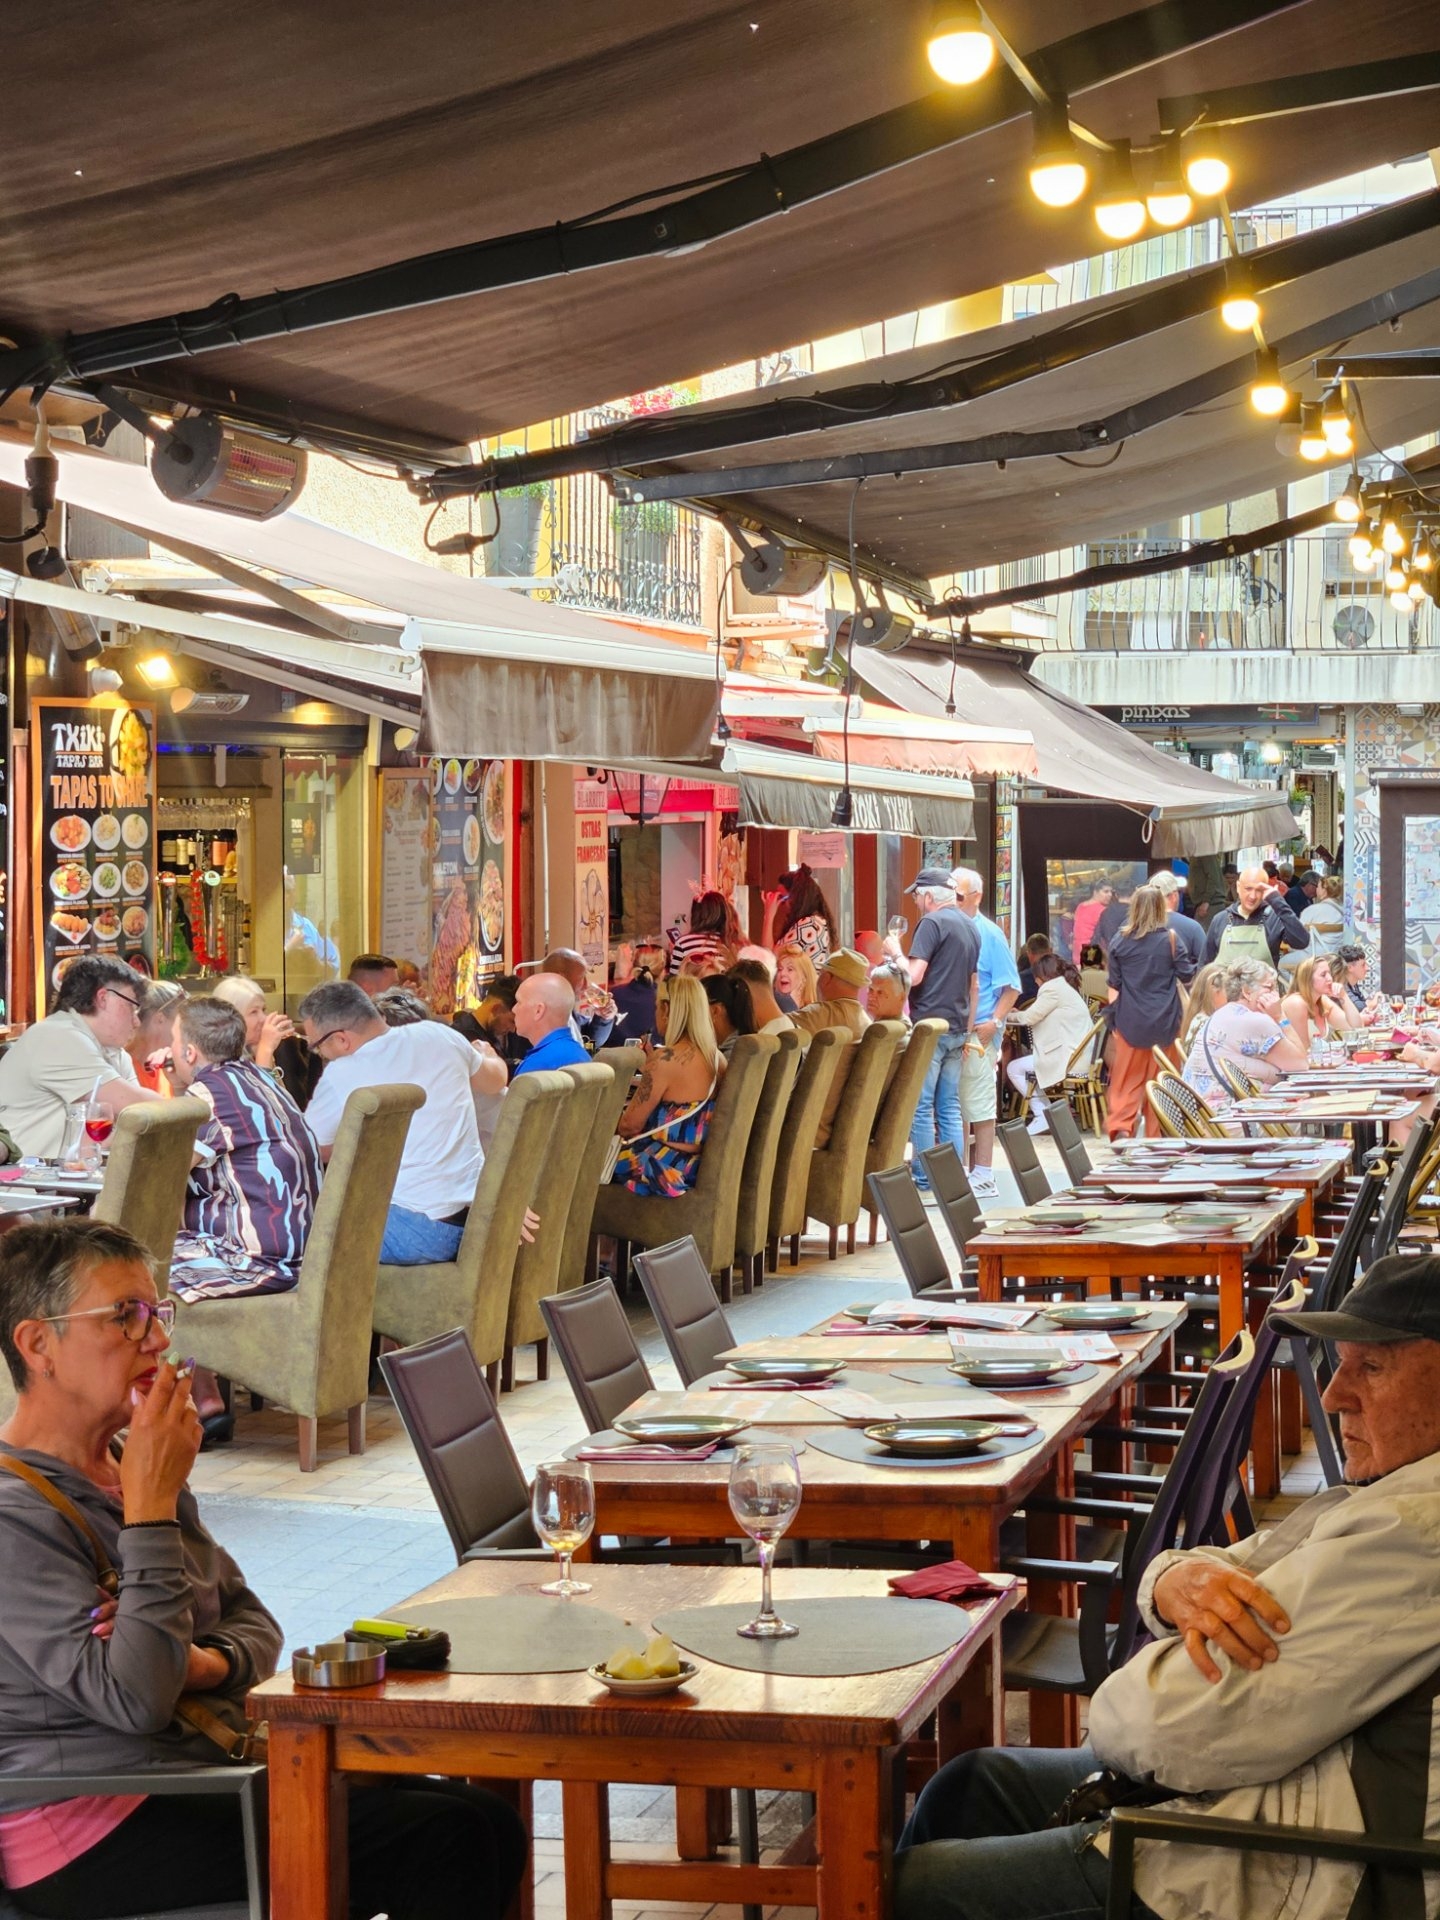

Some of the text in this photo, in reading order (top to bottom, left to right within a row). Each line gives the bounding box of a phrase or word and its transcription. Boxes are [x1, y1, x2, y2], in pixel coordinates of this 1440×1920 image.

[56, 755, 104, 768] TAPAS BAR
[50, 774, 148, 809] TAPAS TO SHARE
[581, 820, 602, 838] OSTRAS
[576, 844, 607, 863] FRANCESAS
